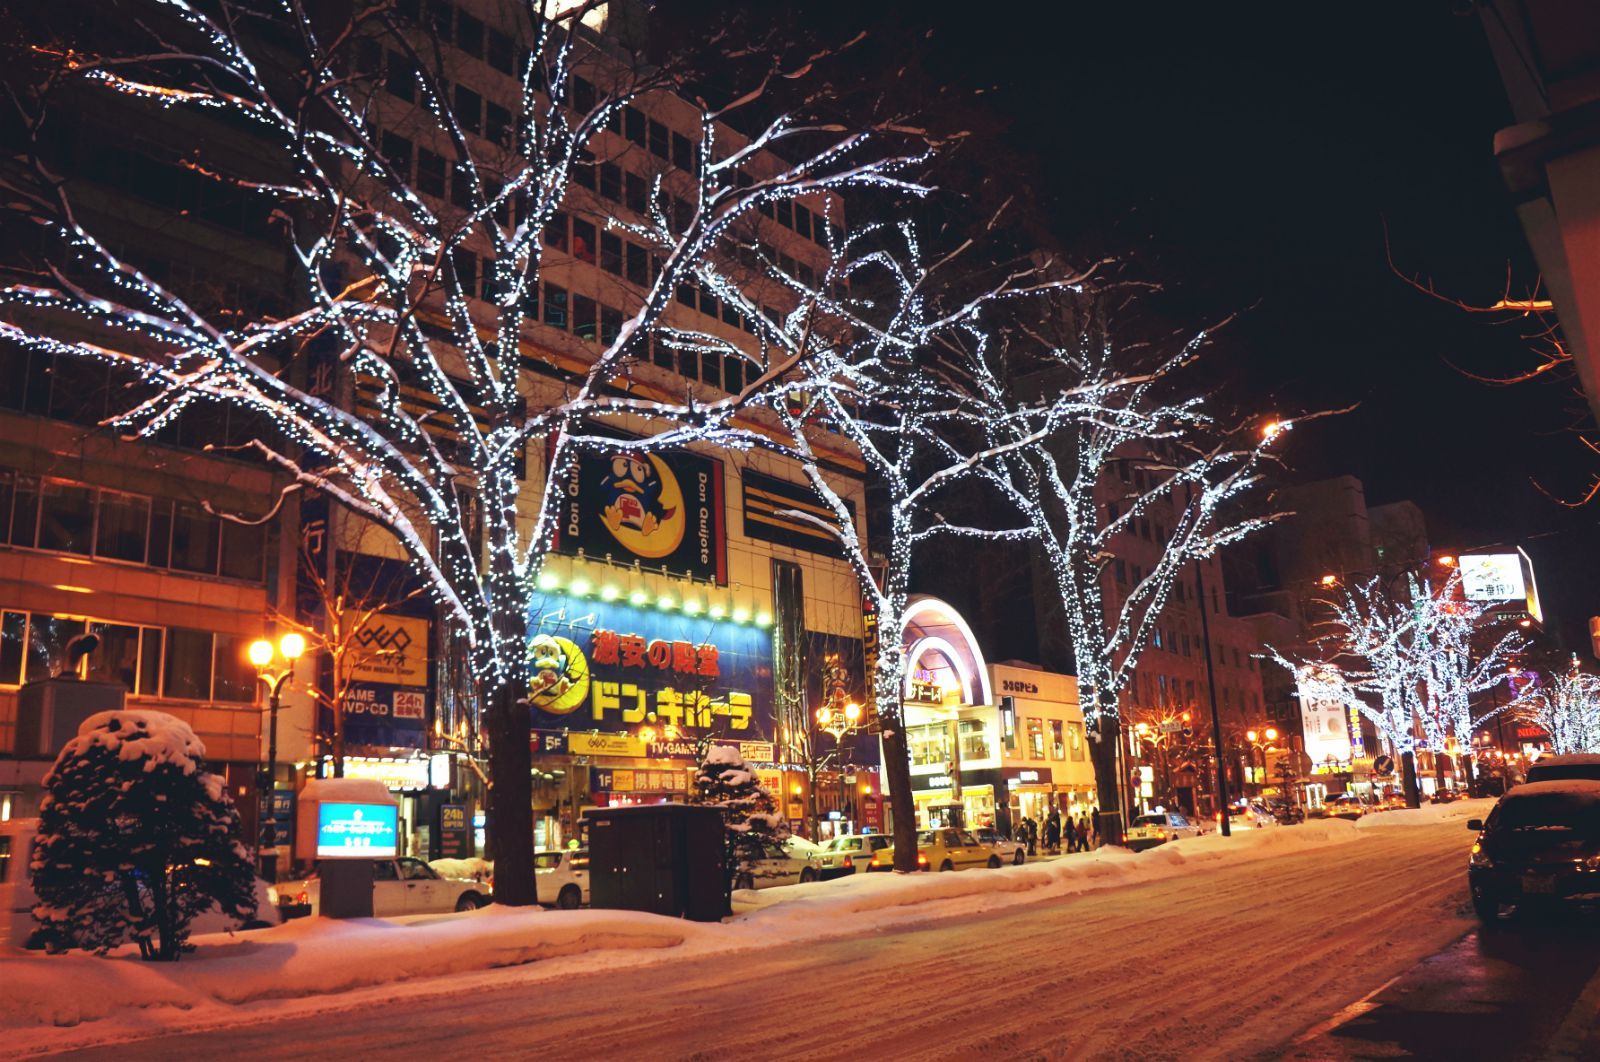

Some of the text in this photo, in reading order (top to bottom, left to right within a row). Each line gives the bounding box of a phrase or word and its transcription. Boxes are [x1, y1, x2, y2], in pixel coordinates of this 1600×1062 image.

[568, 503, 580, 537] Don
[698, 472, 710, 565] Don Quijote
[592, 628, 721, 677] 激安の殿堂
[343, 688, 376, 702] AME
[396, 694, 422, 706] 24h
[545, 736, 562, 750] 5F
[598, 773, 612, 787] 1F
[635, 772, 686, 790] 携帯電話
[443, 808, 464, 820] 24h
